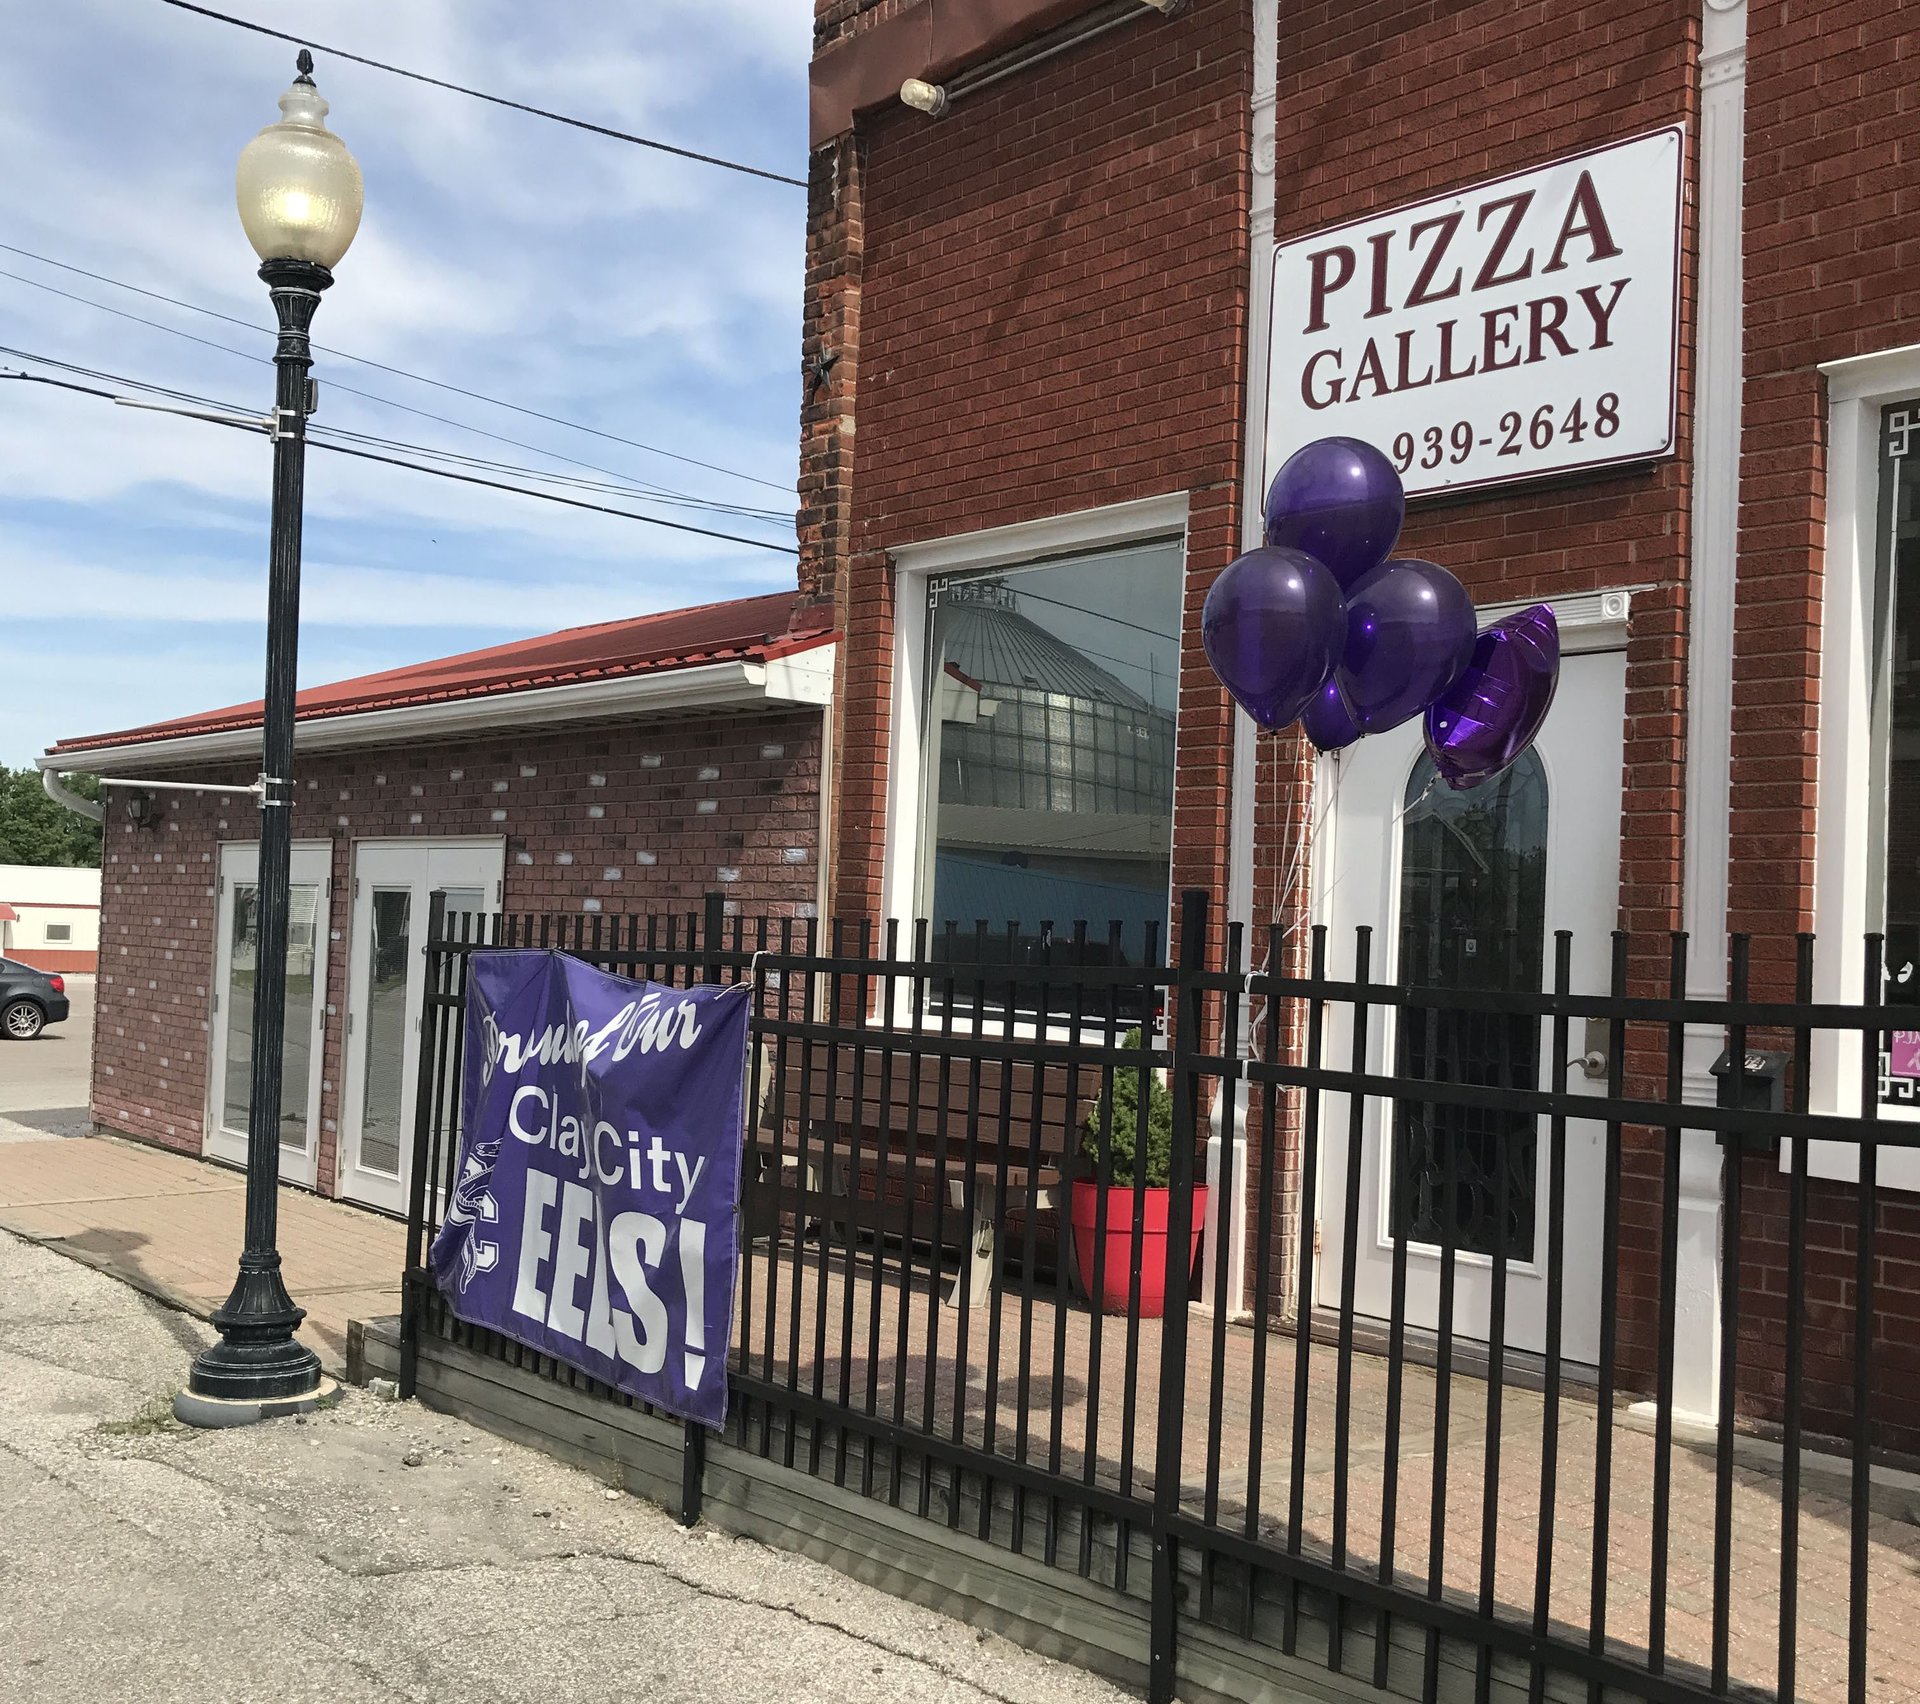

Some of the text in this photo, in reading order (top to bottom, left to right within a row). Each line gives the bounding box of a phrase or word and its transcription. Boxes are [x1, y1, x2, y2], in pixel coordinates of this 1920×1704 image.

[1302, 169, 1624, 335] PIZZA
[1300, 277, 1632, 411] GALLERY
[1392, 392, 1621, 475] 939-2648
[612, 992, 703, 1062] Our
[508, 1085, 706, 1215] Clay City
[511, 1167, 707, 1392] EELS!
